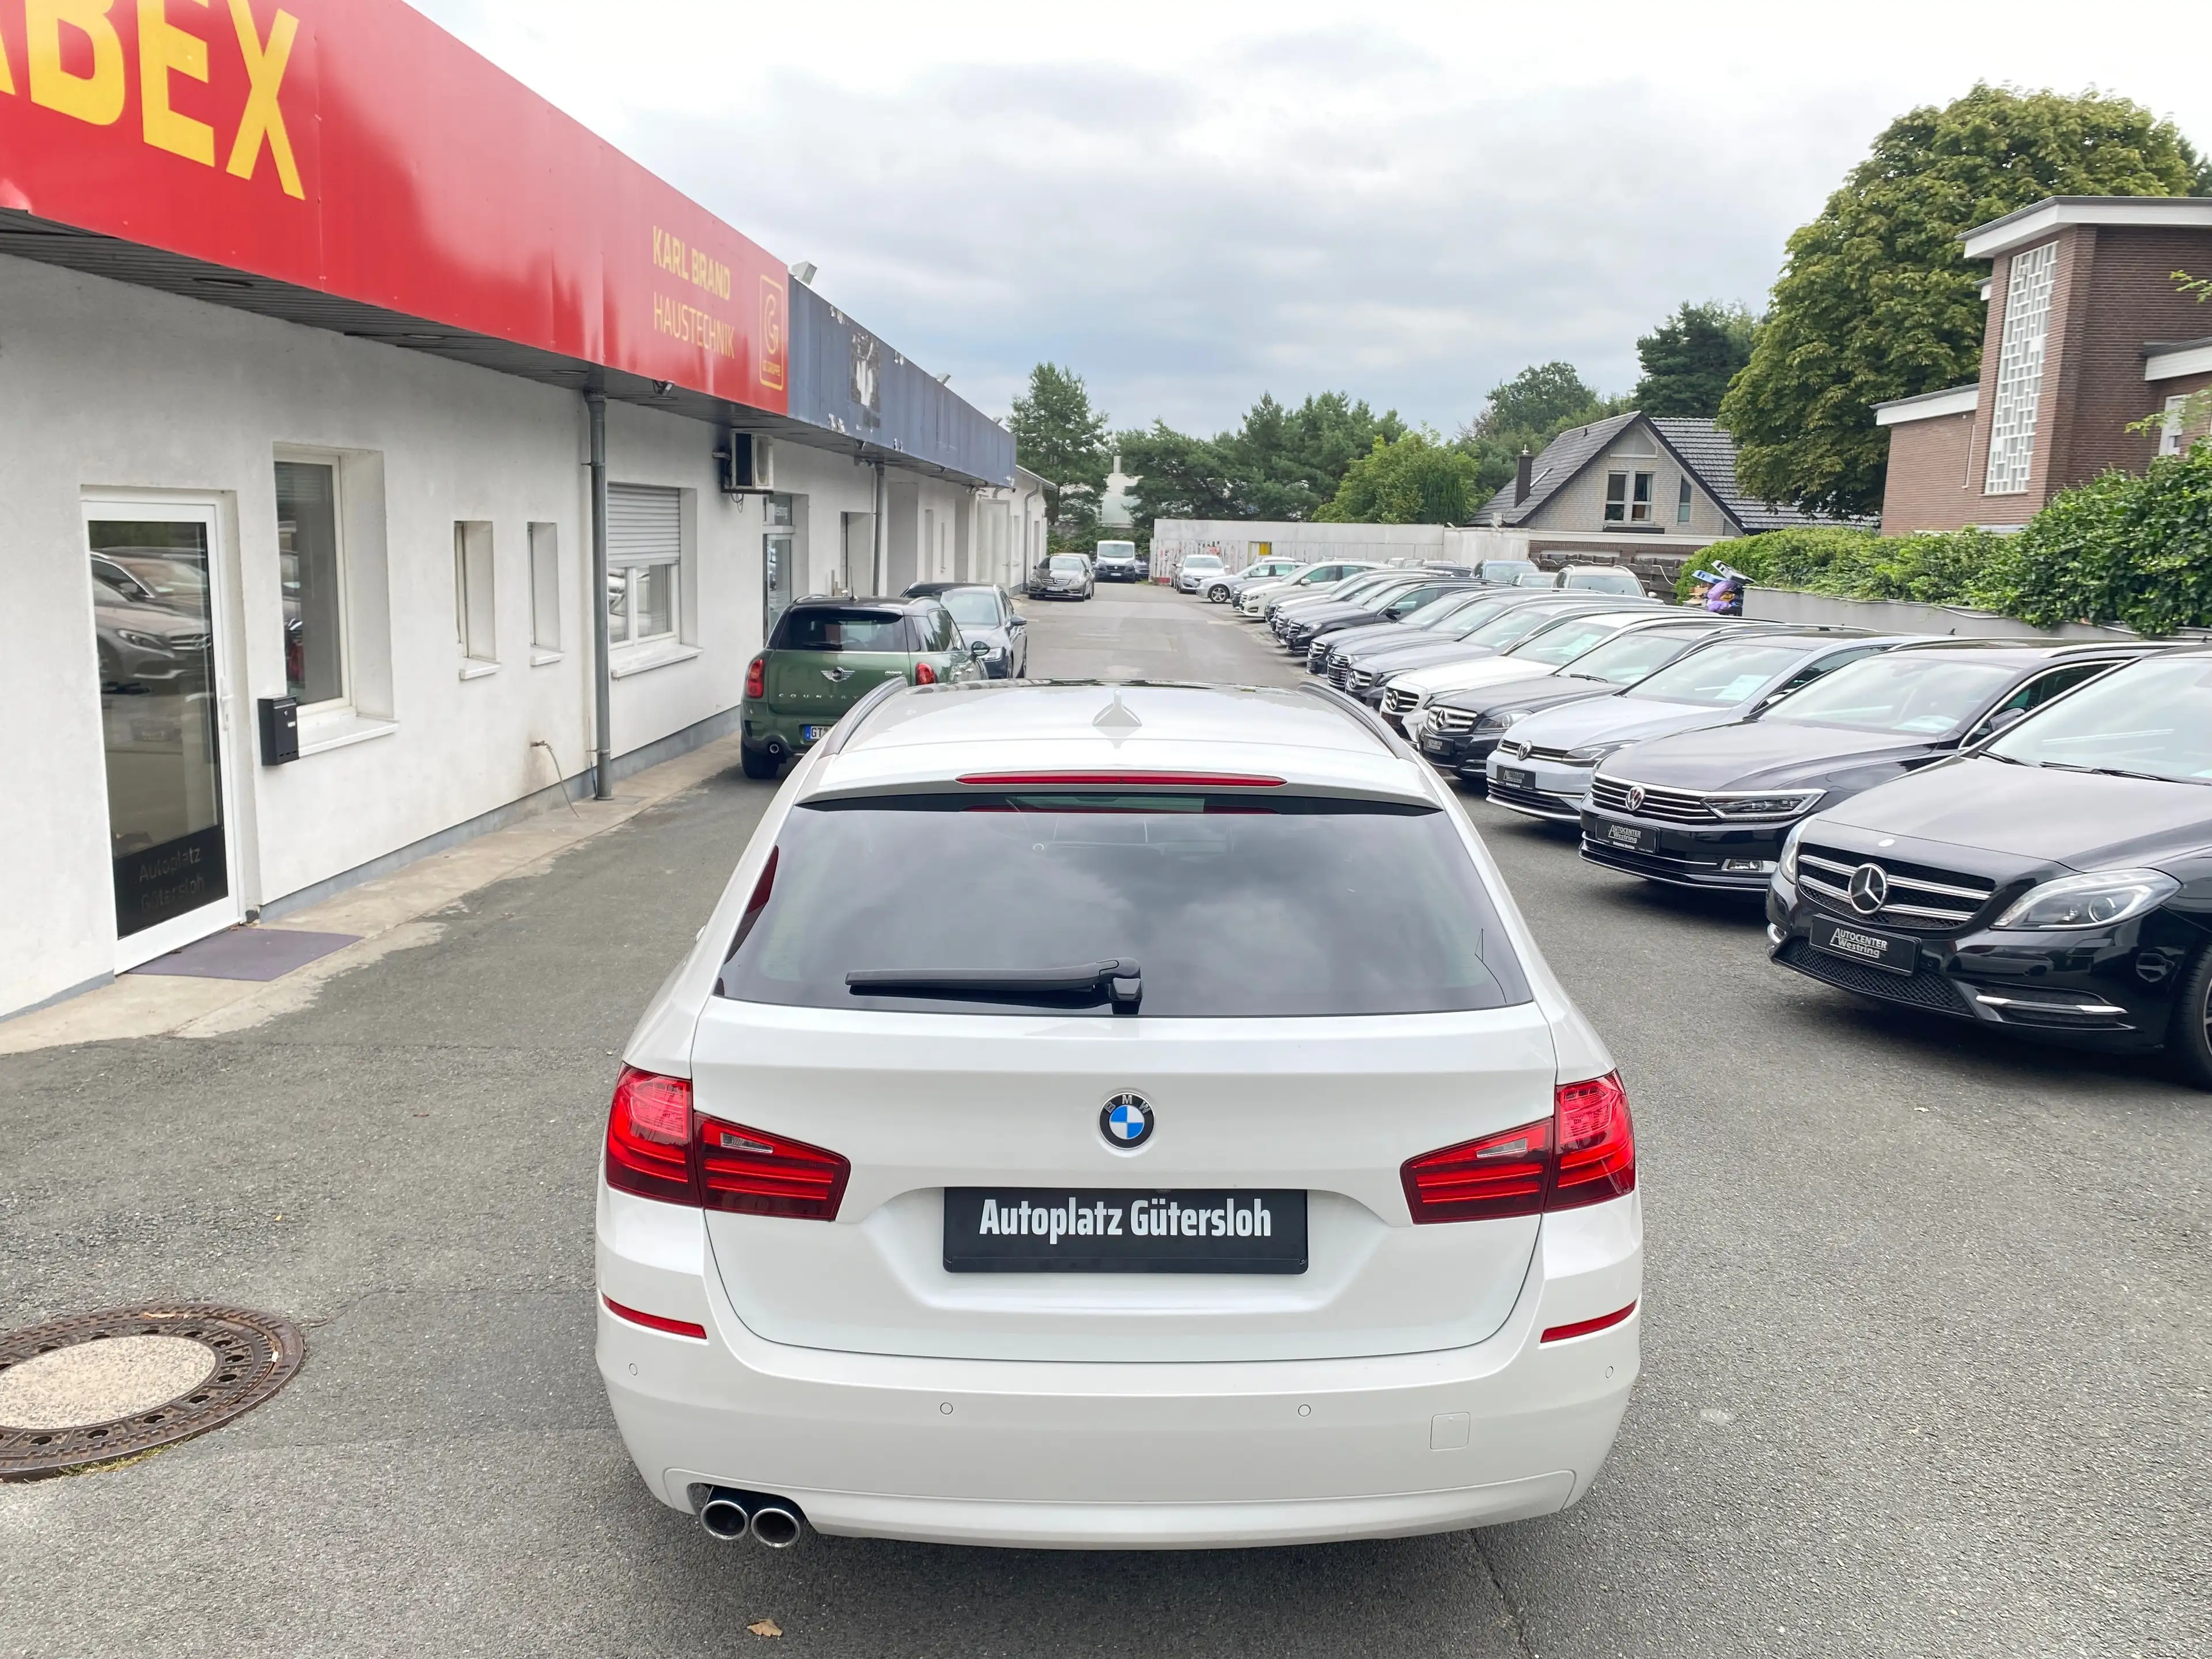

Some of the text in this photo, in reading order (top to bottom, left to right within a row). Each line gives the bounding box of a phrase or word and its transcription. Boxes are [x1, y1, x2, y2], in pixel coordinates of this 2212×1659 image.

[0, 0, 306, 200] BEX
[653, 225, 730, 301] KARL BRAND
[653, 290, 735, 359] HAUSTECHNIK
[811, 728, 823, 737] GT
[1608, 825, 1641, 838] AUTOCENTER
[1613, 831, 1637, 844] Westring
[139, 847, 201, 884] Autoplatz
[1830, 928, 1887, 949] AUTOCENTER
[1838, 937, 1880, 958] Westring
[1104, 1094, 1151, 1113] BMW
[979, 1196, 1271, 1245] Autoplatz Gütersloh
